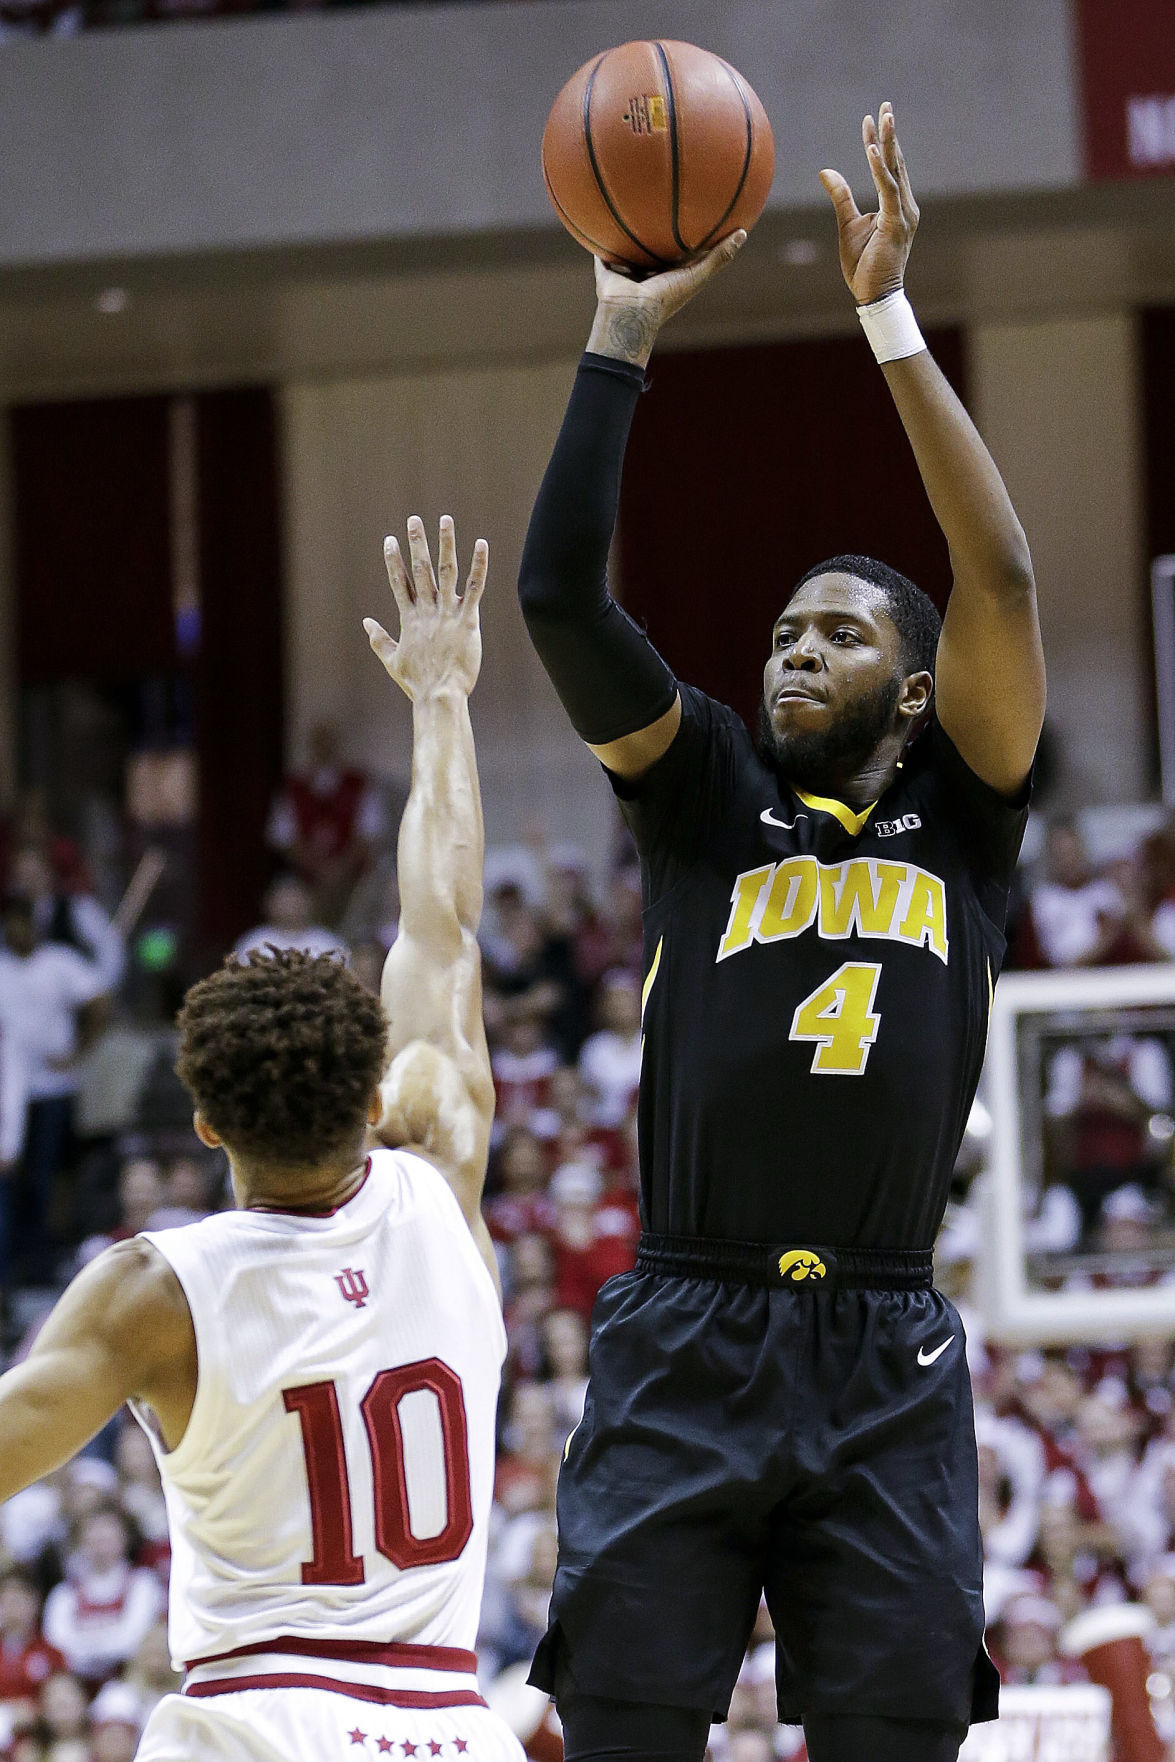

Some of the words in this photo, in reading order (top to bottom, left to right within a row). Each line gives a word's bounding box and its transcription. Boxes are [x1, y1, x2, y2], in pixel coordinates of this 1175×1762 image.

[716, 855, 949, 966] IOWA
[788, 961, 882, 1075] 4
[282, 1357, 474, 1585] 10
